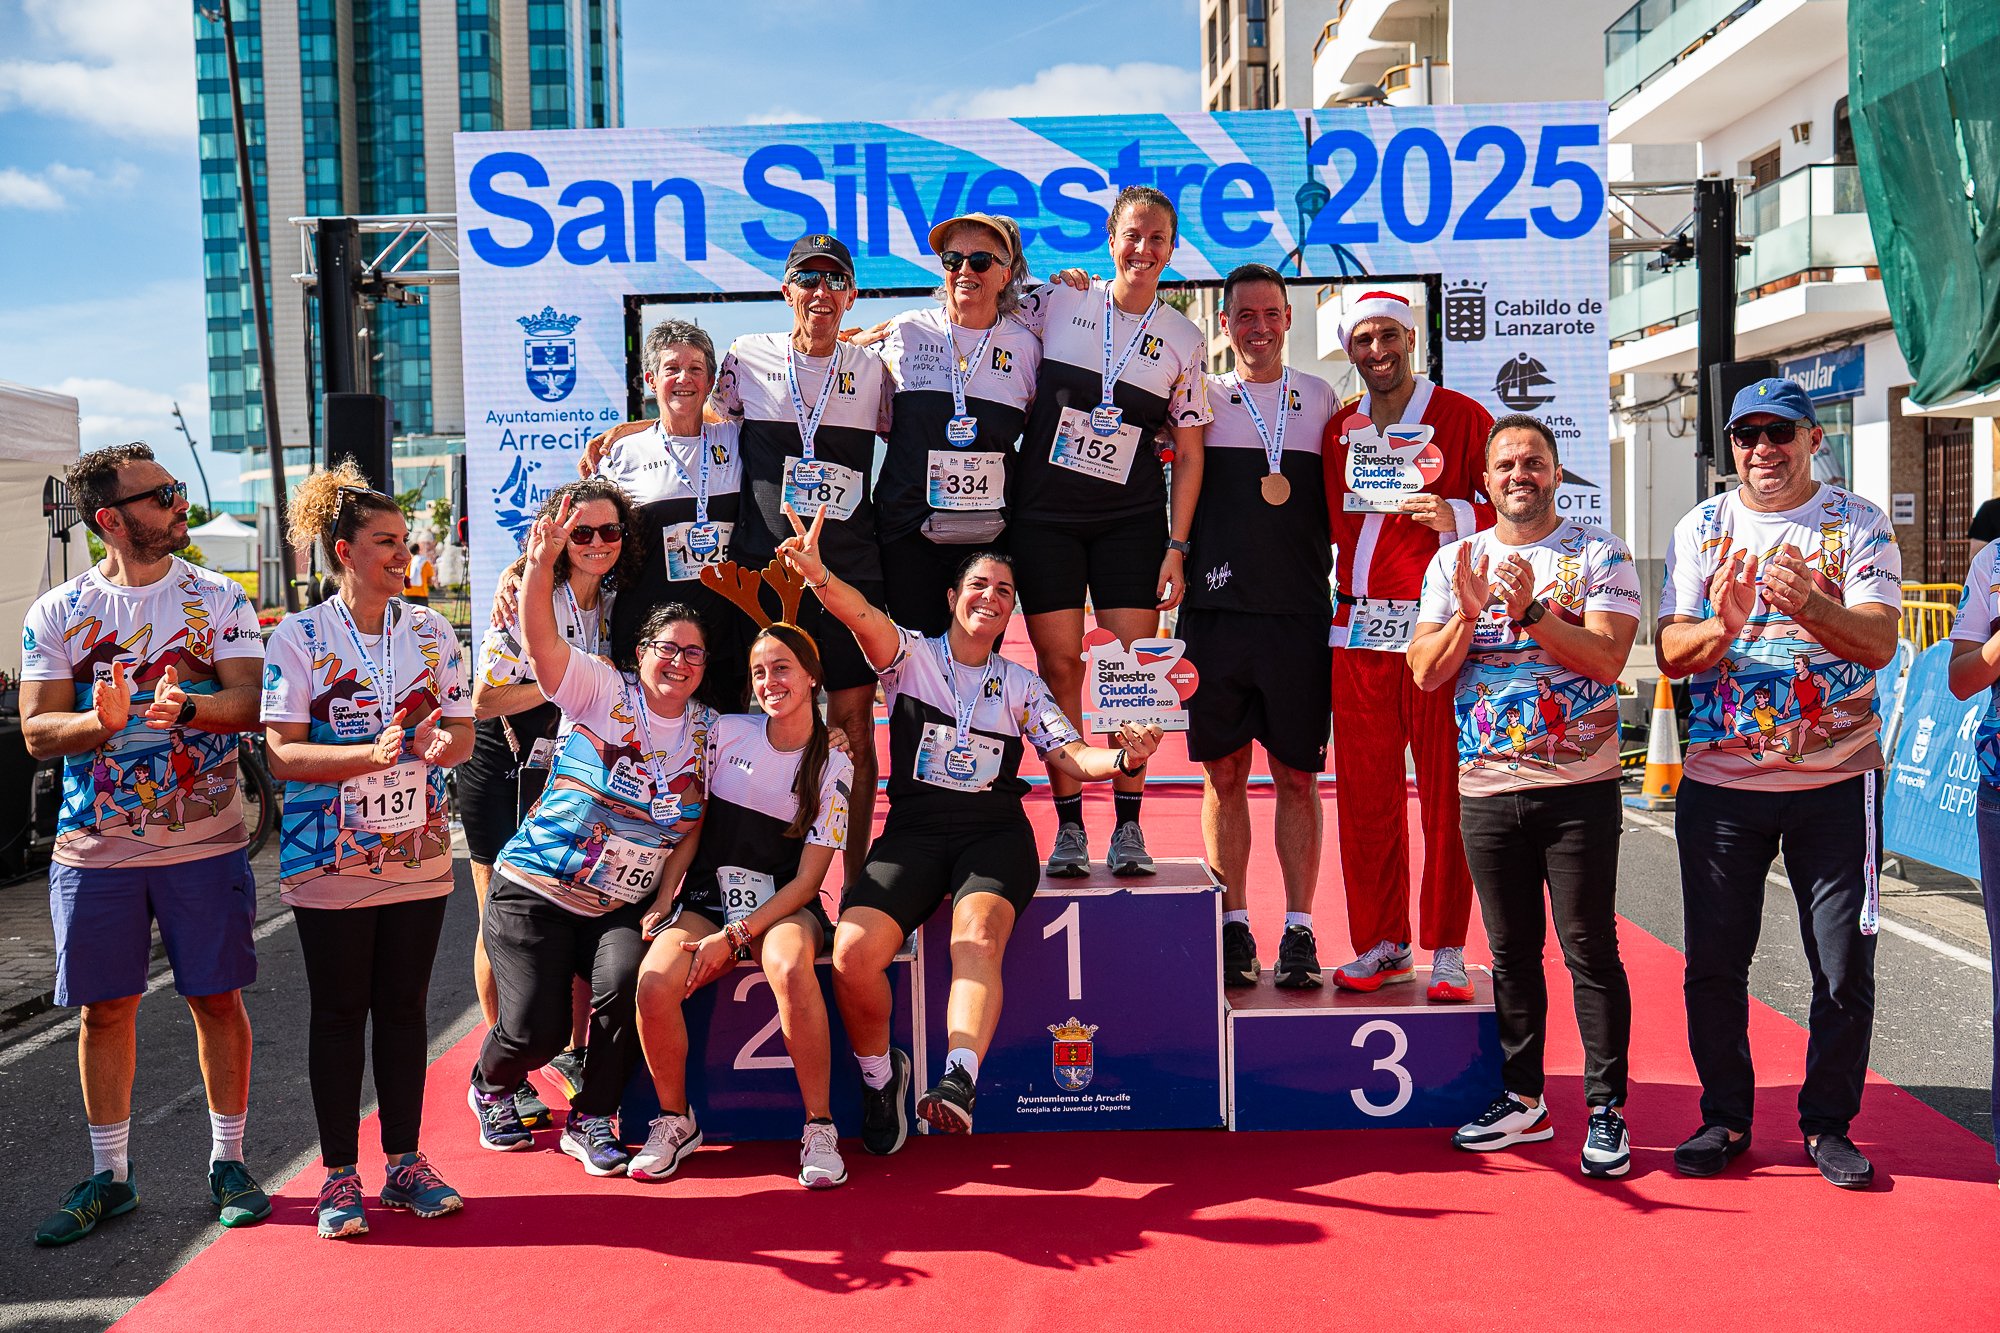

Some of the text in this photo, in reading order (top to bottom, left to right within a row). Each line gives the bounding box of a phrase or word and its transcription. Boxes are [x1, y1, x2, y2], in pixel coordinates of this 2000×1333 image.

[468, 152, 706, 267] San
[1305, 124, 1604, 244] 2025
[1495, 298, 1603, 317] Cabildo de
[1072, 316, 1097, 331] GOBIK
[1495, 319, 1595, 336] Lanzarote
[919, 344, 944, 354] GOBIK
[767, 373, 786, 382] GOBI
[486, 408, 620, 427] Ayuntamiento de
[1545, 415, 1576, 427] Arte,
[1551, 429, 1581, 438] ismo
[1074, 435, 1117, 464] 152
[1354, 443, 1377, 453] San
[1353, 455, 1404, 465] Silvestre
[1352, 466, 1405, 477] Ciudad de
[946, 474, 989, 495] 334
[1352, 478, 1401, 489] Arrecife
[807, 484, 846, 504] 187
[1558, 494, 1600, 509] OTE
[1570, 516, 1602, 525] TION
[1368, 618, 1409, 638] 251
[1098, 659, 1124, 670] San
[1098, 671, 1155, 683] Silvestre
[1098, 683, 1147, 695] Ciudad
[1099, 696, 1155, 708] Arrecife
[332, 705, 349, 713] San
[333, 711, 369, 720] Silvestre
[336, 719, 364, 728] Ciudad
[1832, 719, 1851, 730] 2025
[337, 727, 368, 735] Arrecife
[1578, 732, 1596, 742] 2025
[618, 762, 630, 772] San
[612, 774, 639, 790] Ciudad
[616, 768, 644, 785] Silvestre
[1896, 771, 1926, 789] Arrecife
[207, 783, 228, 795] 2025
[609, 781, 639, 799] Arrecife
[356, 787, 417, 818] 1137
[1939, 783, 1977, 817] DEPO
[616, 865, 654, 889] 156
[722, 889, 758, 908] 83
[1043, 901, 1081, 1000] 1
[733, 972, 796, 1070] 2
[1350, 1020, 1413, 1116] 3
[1017, 1093, 1131, 1105] Ayuntamiento de Arrecife
[1100, 1104, 1131, 1112] Deportes
